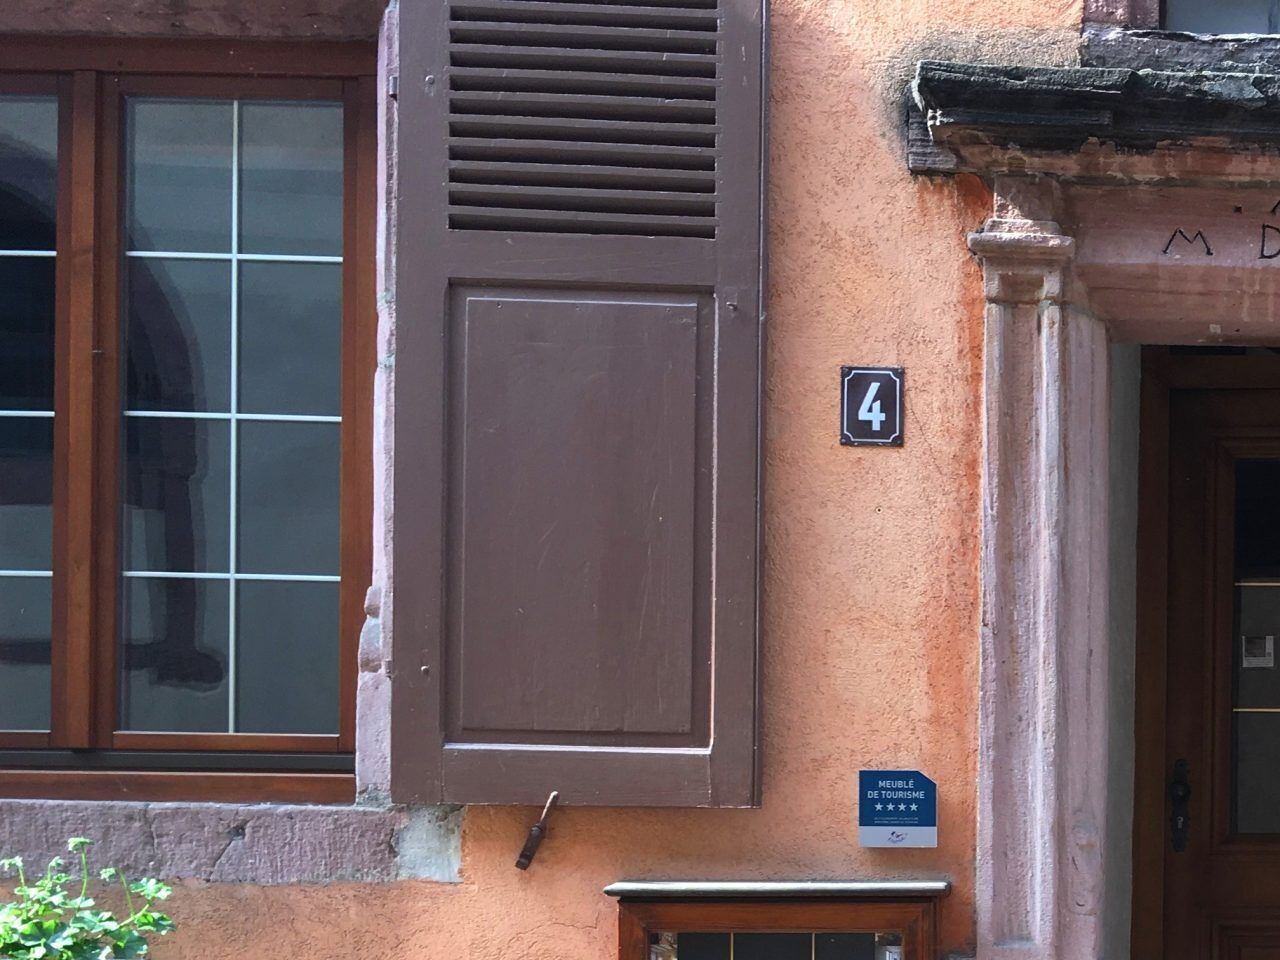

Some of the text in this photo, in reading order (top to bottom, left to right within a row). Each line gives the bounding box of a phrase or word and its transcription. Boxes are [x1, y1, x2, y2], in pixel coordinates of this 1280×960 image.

[1162, 228, 1214, 256] M
[858, 382, 886, 431] 4
[867, 791, 925, 799] DE TOURISME
